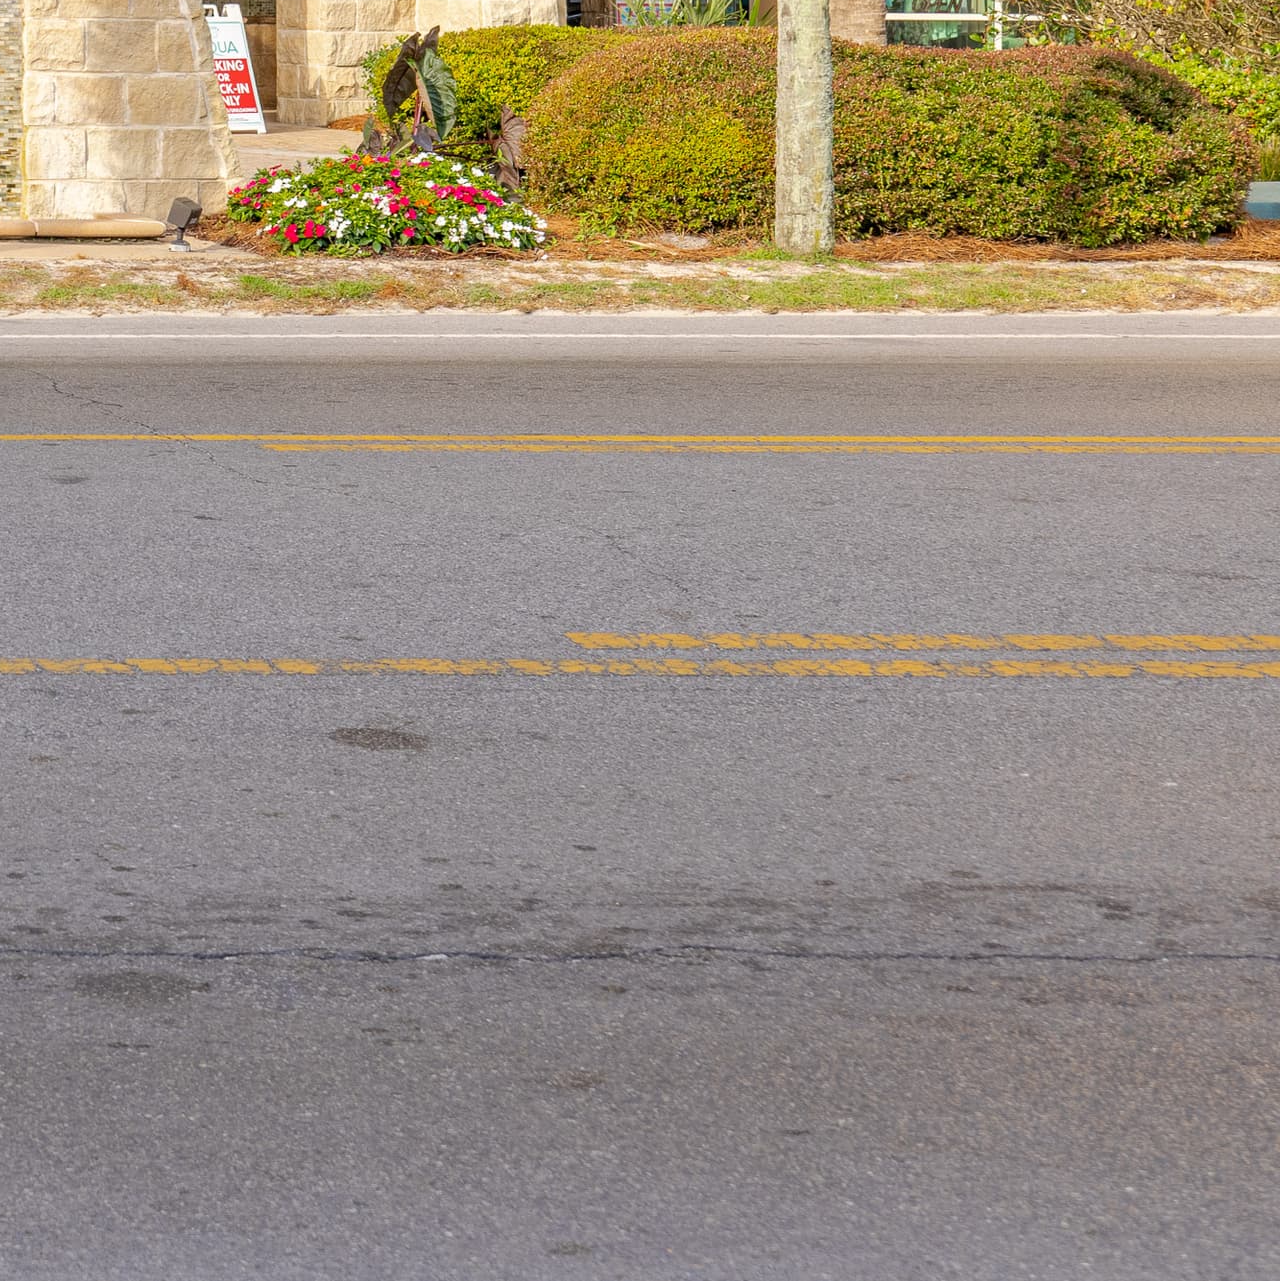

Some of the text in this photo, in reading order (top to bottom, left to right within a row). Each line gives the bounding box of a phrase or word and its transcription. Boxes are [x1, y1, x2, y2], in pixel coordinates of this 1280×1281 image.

[214, 60, 244, 72] KING
[215, 72, 231, 82] OR
[220, 82, 250, 95] CK-IN
[222, 94, 240, 106] NLY
